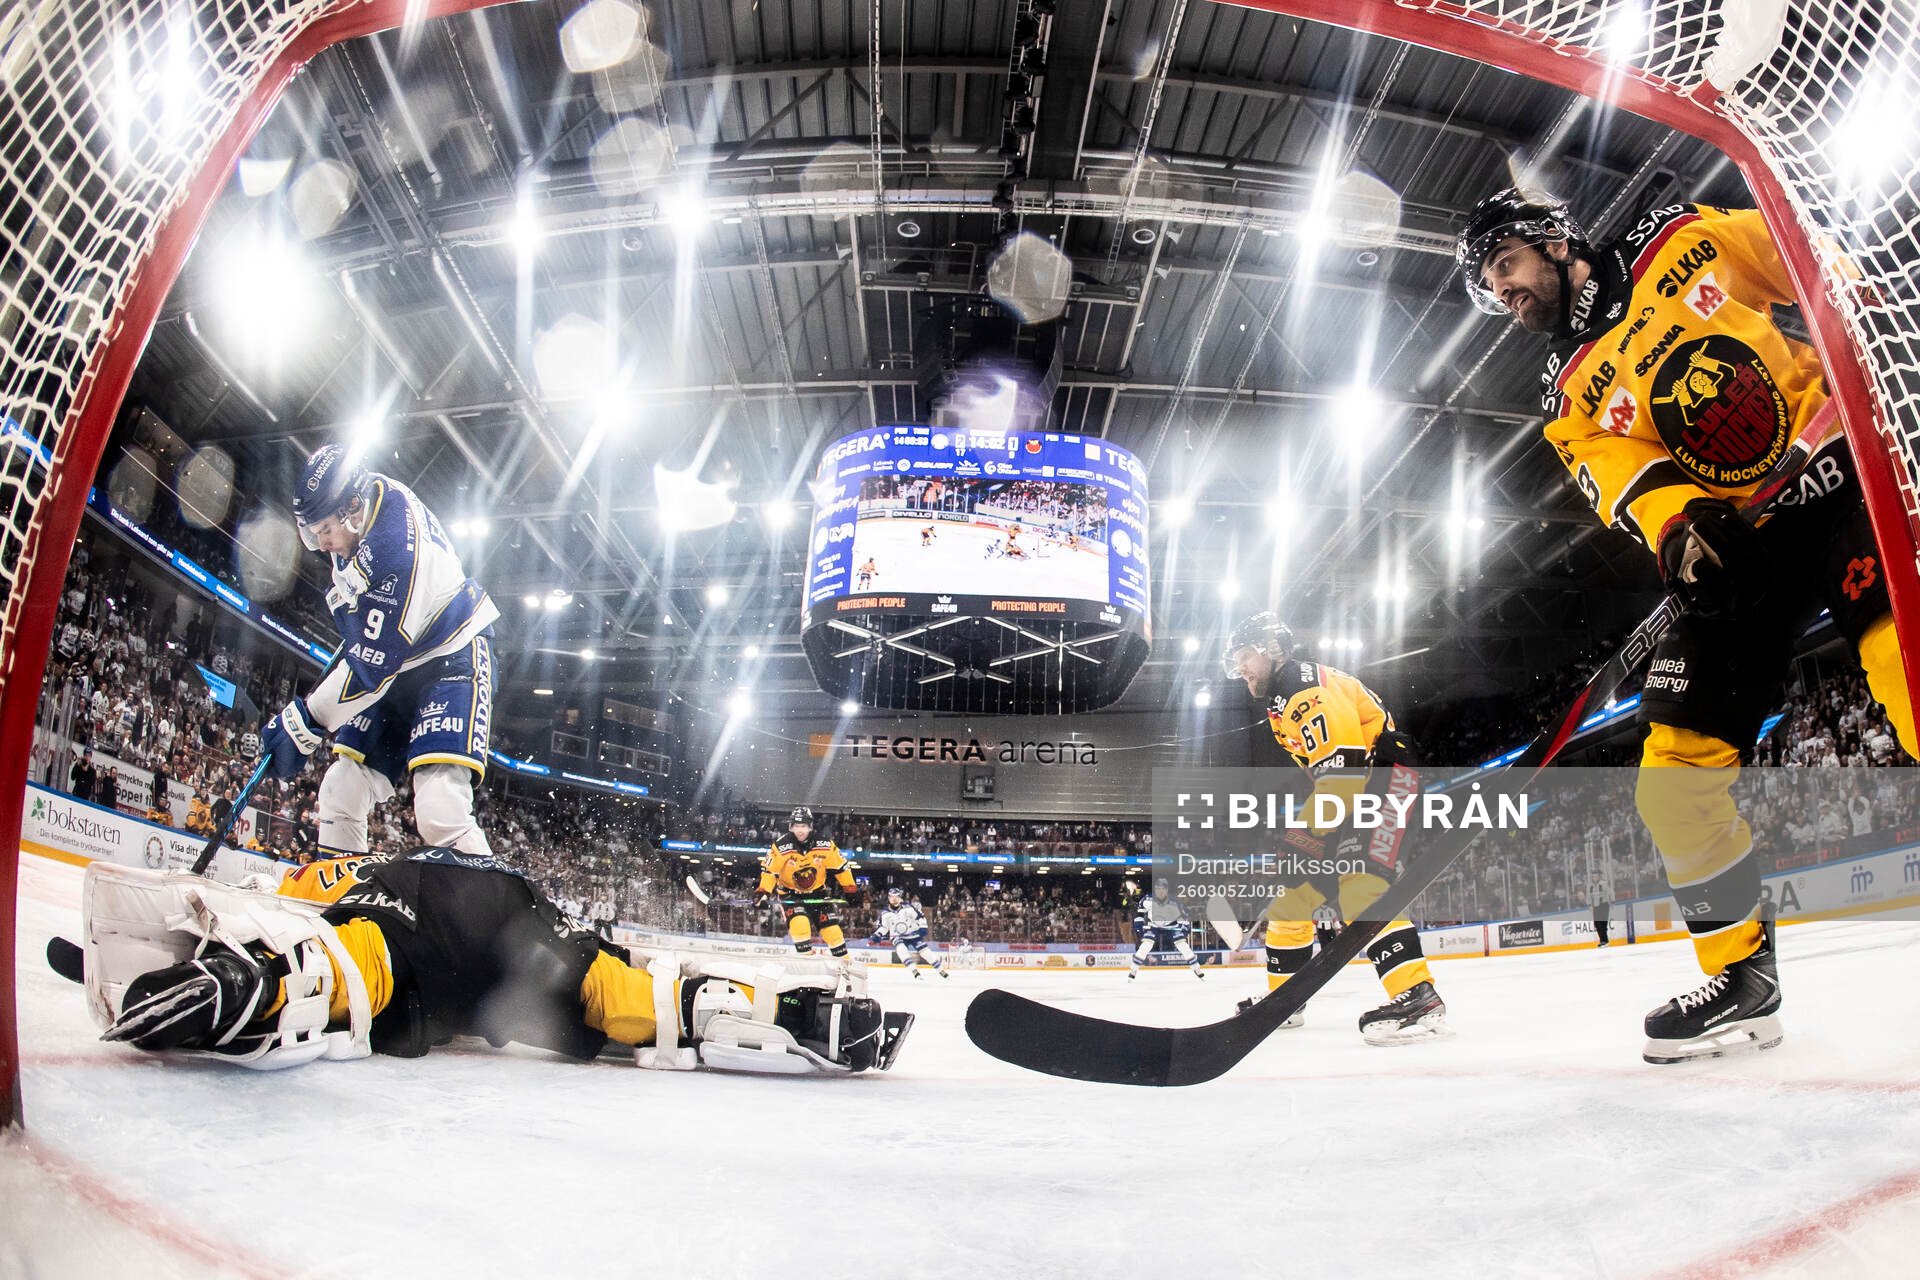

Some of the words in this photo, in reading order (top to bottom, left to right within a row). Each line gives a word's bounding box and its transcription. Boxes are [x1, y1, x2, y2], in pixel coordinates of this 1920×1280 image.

[1669, 239, 1717, 286] LKAB
[1575, 279, 1599, 320] LKAB
[1635, 324, 1687, 378] SCANIA
[1576, 361, 1617, 418] LKAB
[1675, 446, 1716, 480] LULEÅ
[837, 598, 878, 611] PROTECTING
[878, 597, 906, 608] PEOPLE
[991, 600, 1037, 612] PROTECTING
[1038, 601, 1066, 613] PEOPLE
[363, 607, 385, 641] 9
[348, 642, 386, 666] AEB
[410, 717, 464, 744] SAFE4U
[1301, 712, 1329, 754] 67
[845, 734, 987, 764] TEGERA
[998, 740, 1099, 766] arena
[48, 800, 121, 845] bokstaven
[170, 840, 185, 853] Visa
[186, 844, 199, 857] ditt
[996, 955, 1025, 966] JULA
